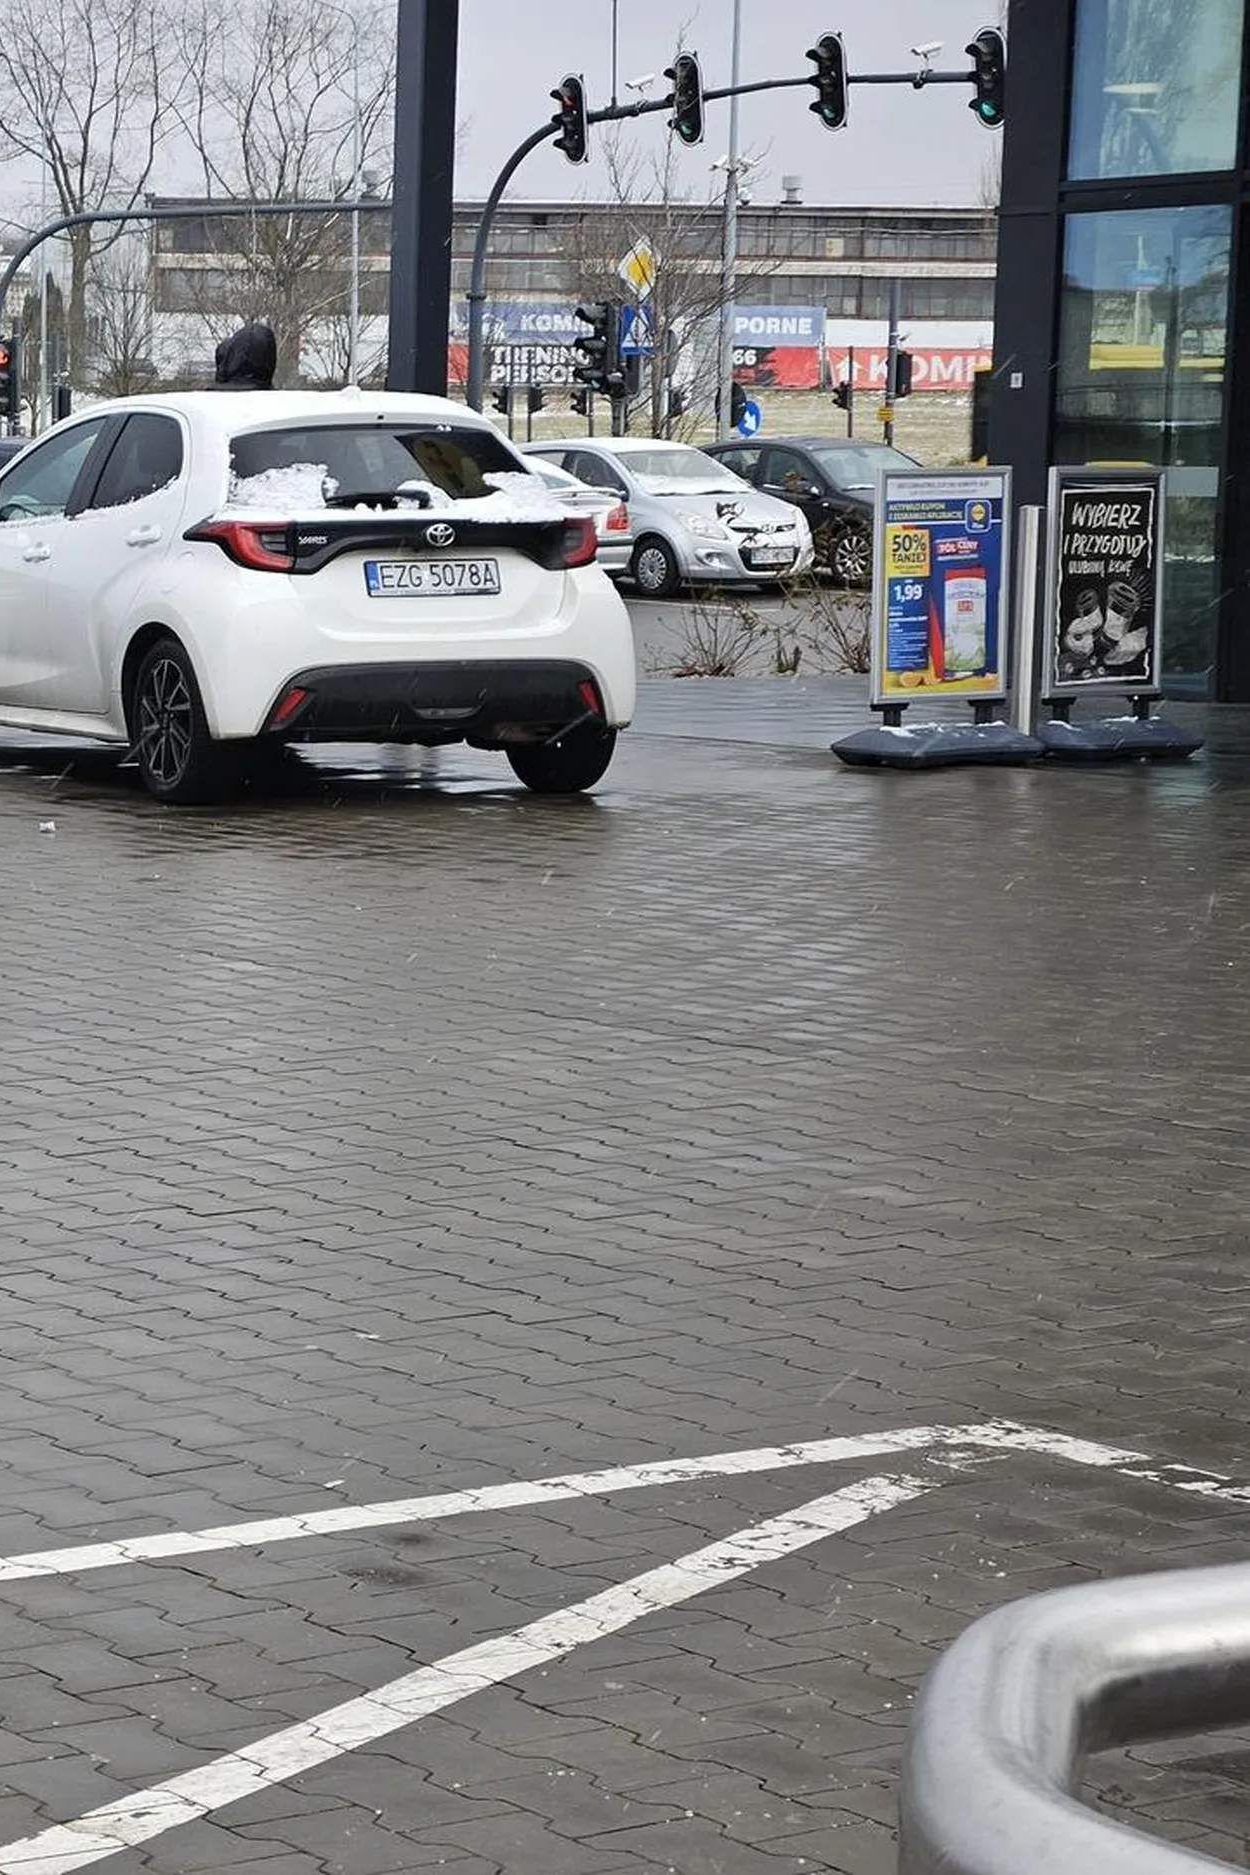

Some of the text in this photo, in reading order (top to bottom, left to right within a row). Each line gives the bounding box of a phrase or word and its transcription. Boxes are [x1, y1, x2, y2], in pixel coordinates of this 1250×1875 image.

[734, 316, 812, 335] PORNE
[1071, 502, 1142, 529] WYBIERZ
[891, 534, 927, 552] 50%
[1063, 533, 1147, 558] I PRZYGOTUJ
[891, 553, 927, 564] TANIEJ
[379, 562, 496, 589] EZG 5078A
[893, 584, 923, 603] 1,99
